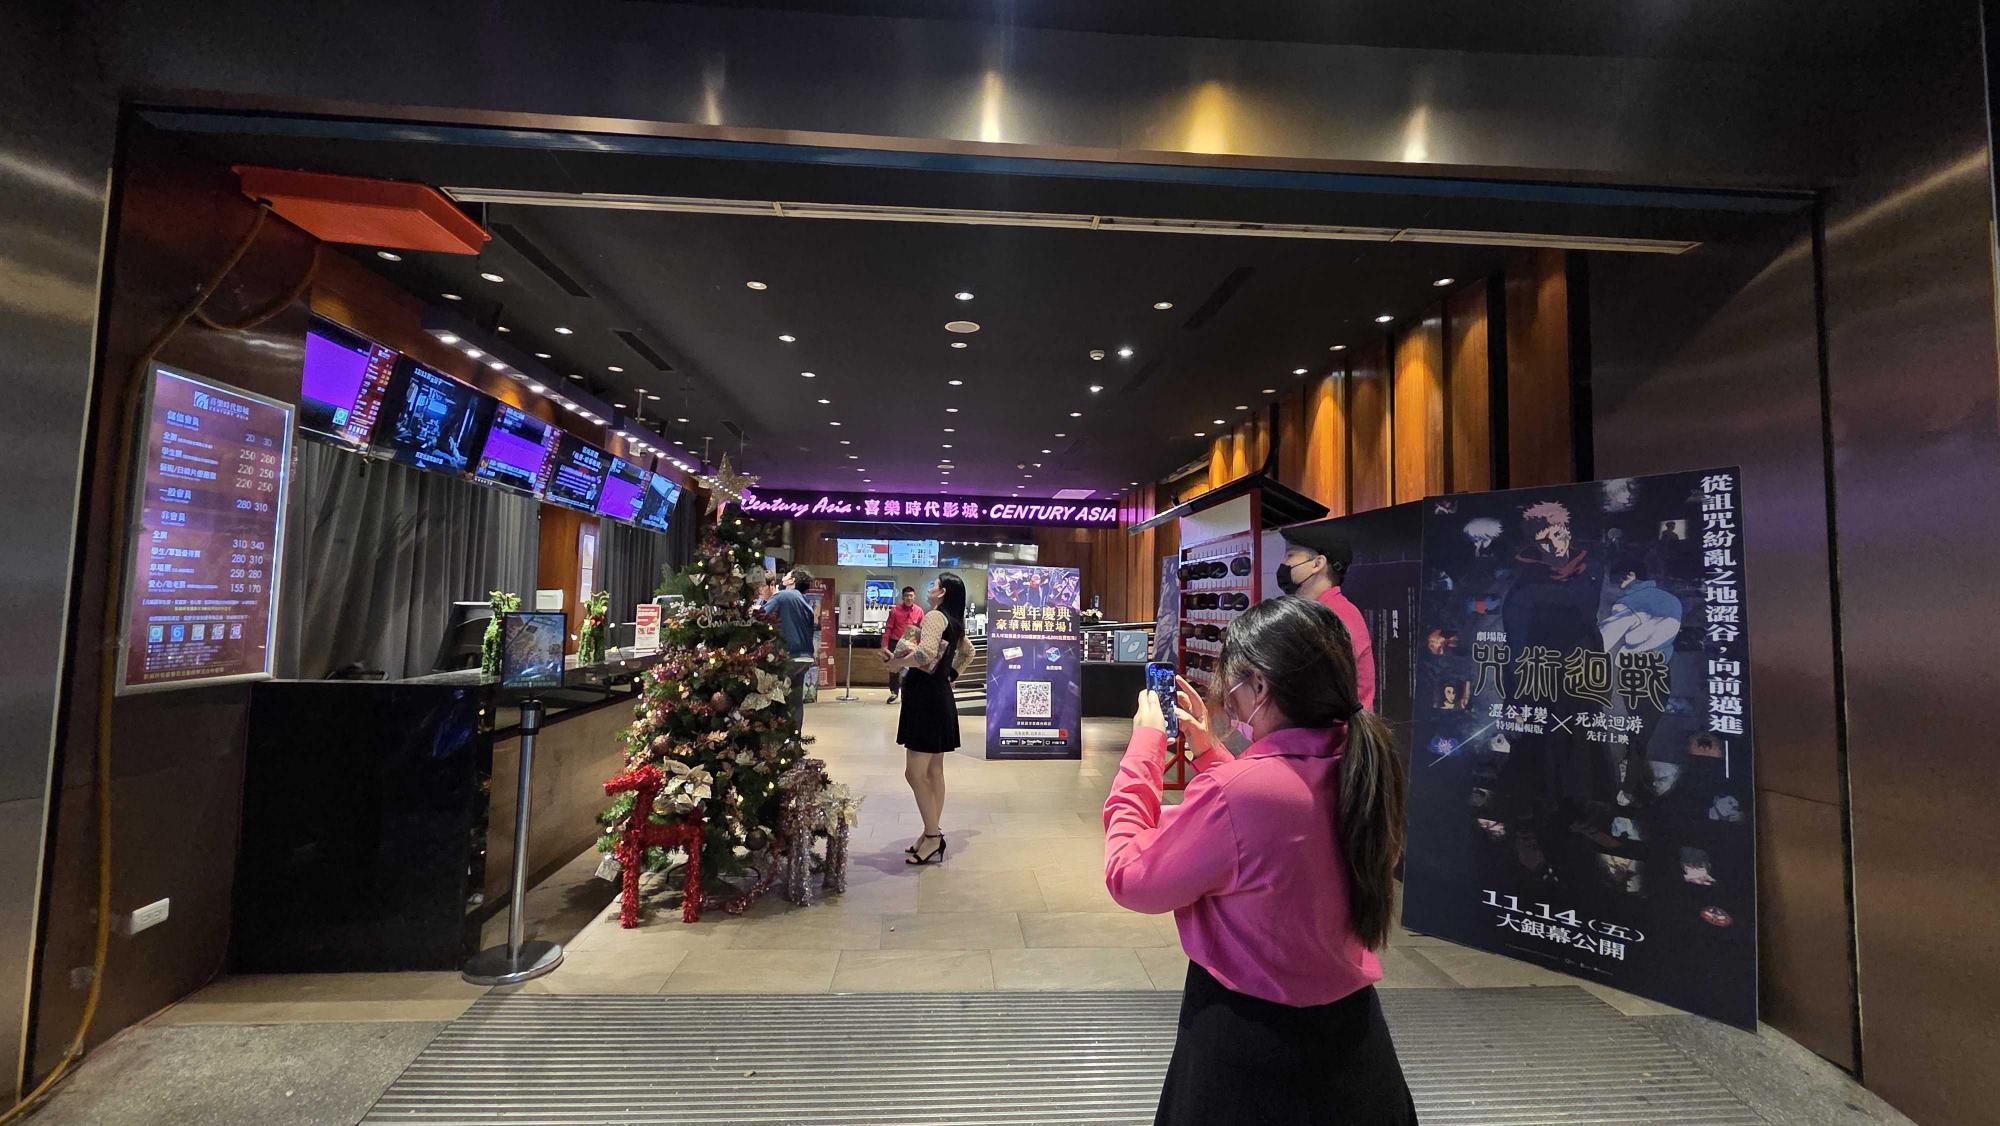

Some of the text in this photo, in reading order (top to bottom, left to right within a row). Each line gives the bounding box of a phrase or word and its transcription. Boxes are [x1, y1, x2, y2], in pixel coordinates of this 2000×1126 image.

[239, 448, 256, 461] 250
[259, 468, 275, 479] 250
[236, 499, 268, 512] 280 310
[741, 495, 1117, 522] Century Asia 喜樂時代影城 CENTURY ASIA
[232, 539, 265, 551] 310 340
[249, 555, 264, 565] 310
[230, 583, 262, 594] 155 170
[997, 604, 1072, 621] 一週年慶典
[1476, 631, 1507, 643] 劇場版
[1472, 643, 1671, 713] 咒術迴戰
[1488, 703, 1548, 725] 澀谷事變
[1574, 711, 1645, 735] 死滅迴游
[1586, 730, 1630, 746] 先行上映
[1496, 913, 1626, 961] 大銀幕公開
